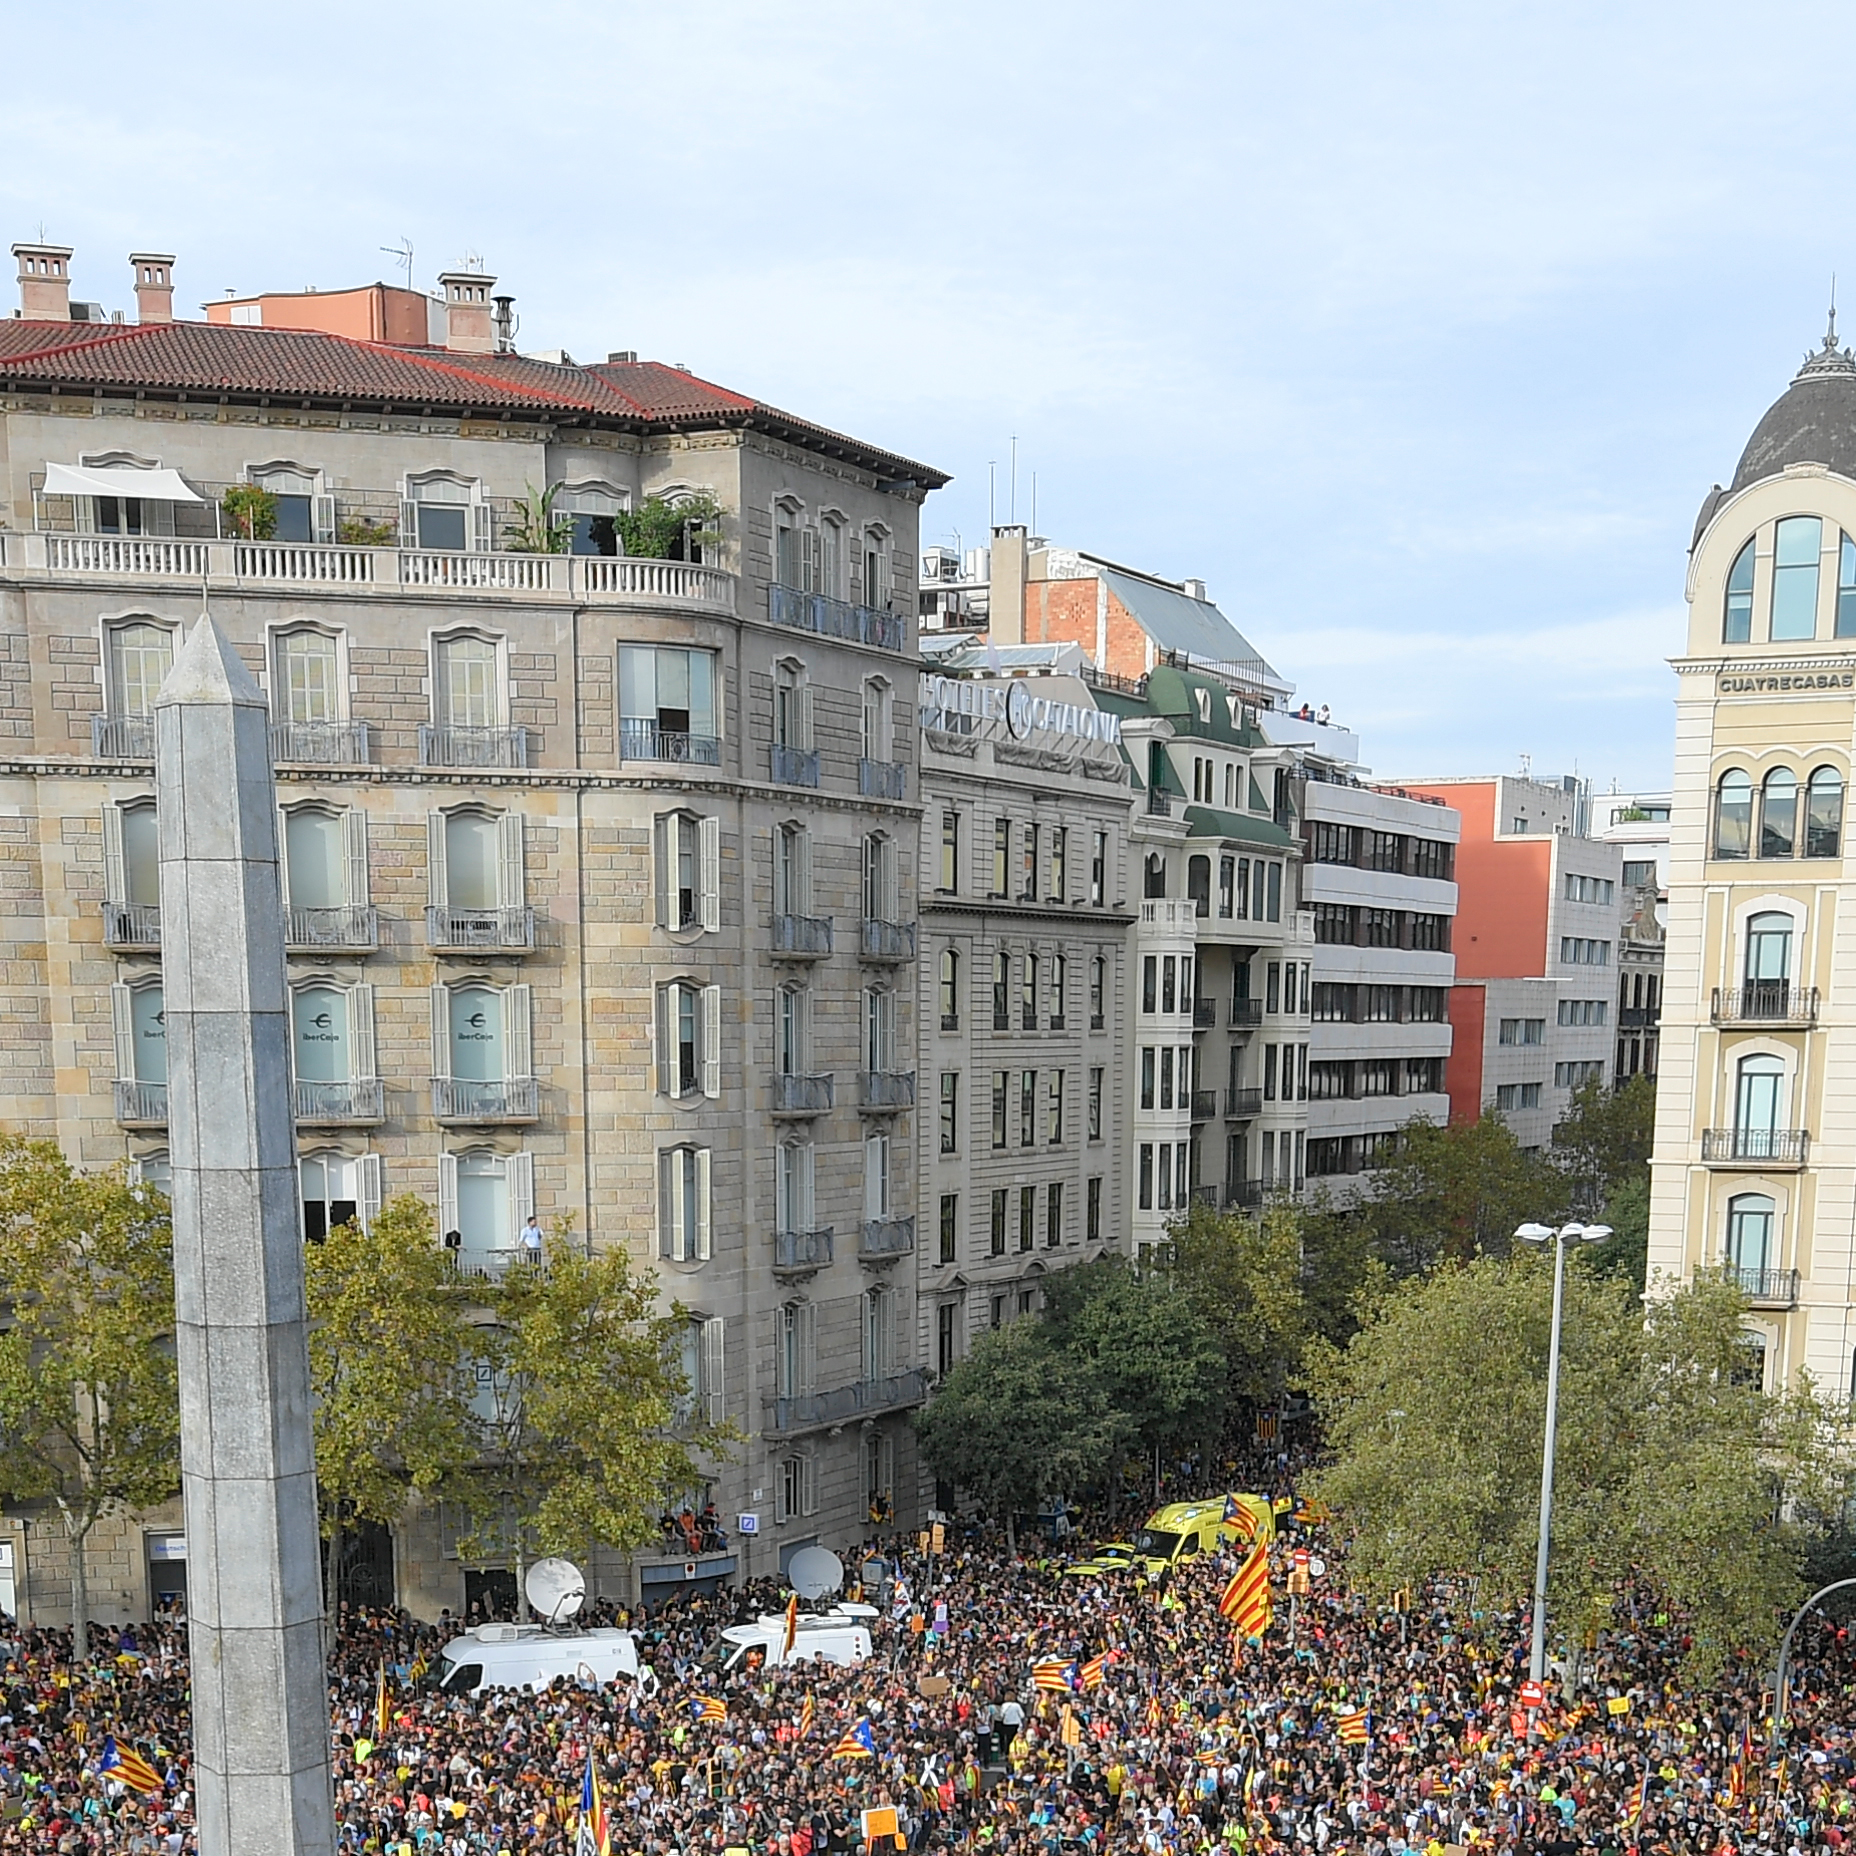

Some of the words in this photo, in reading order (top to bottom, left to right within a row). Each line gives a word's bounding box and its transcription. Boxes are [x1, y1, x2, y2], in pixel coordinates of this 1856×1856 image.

[1719, 673, 1853, 692] CUATRECASAS
[920, 672, 1006, 722] HOTELES
[1032, 697, 1121, 745] CATALONIA
